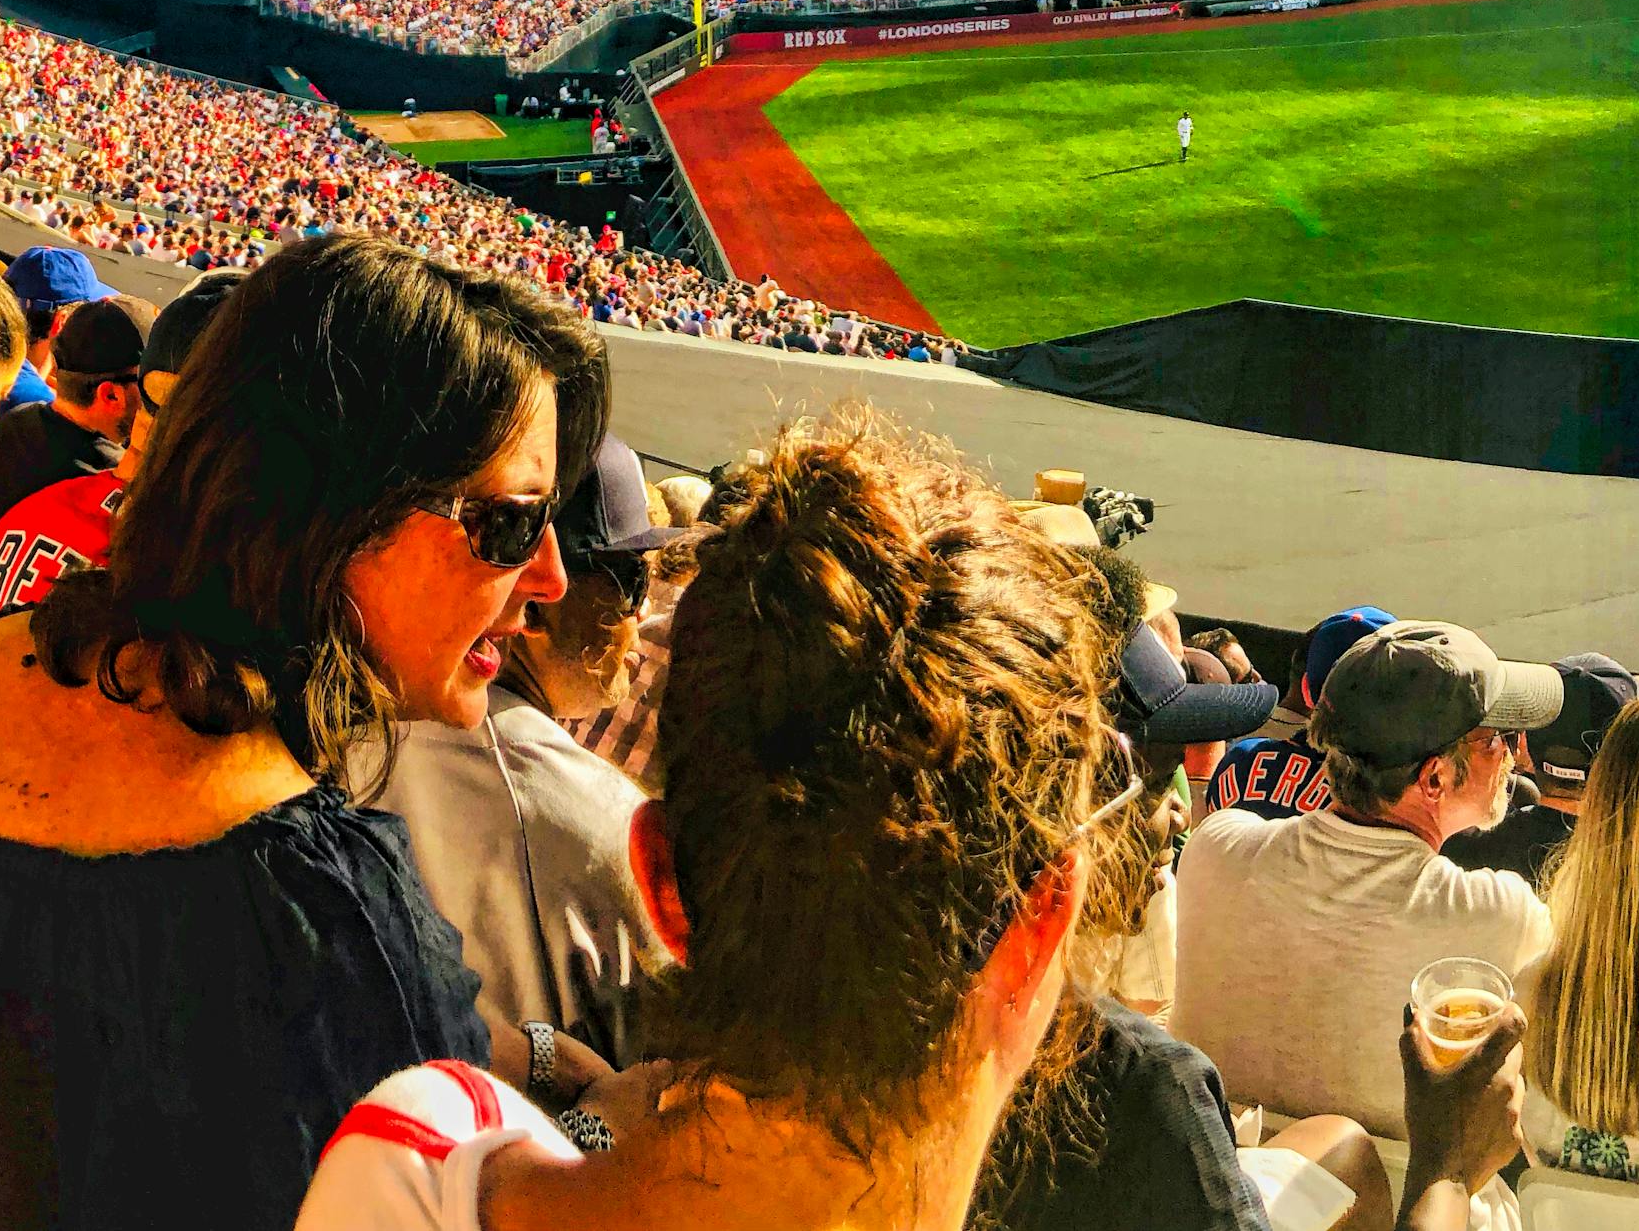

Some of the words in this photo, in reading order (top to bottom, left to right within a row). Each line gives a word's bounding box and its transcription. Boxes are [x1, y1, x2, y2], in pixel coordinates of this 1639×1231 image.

[1053, 15, 1072, 25] OLD
[1073, 12, 1108, 24] RIVALRY
[1136, 6, 1171, 18] GROUN
[784, 32, 814, 49] RED
[817, 29, 847, 46] SOX
[878, 18, 1011, 41] #LONDONSERIES
[1210, 751, 1333, 813] DERG
